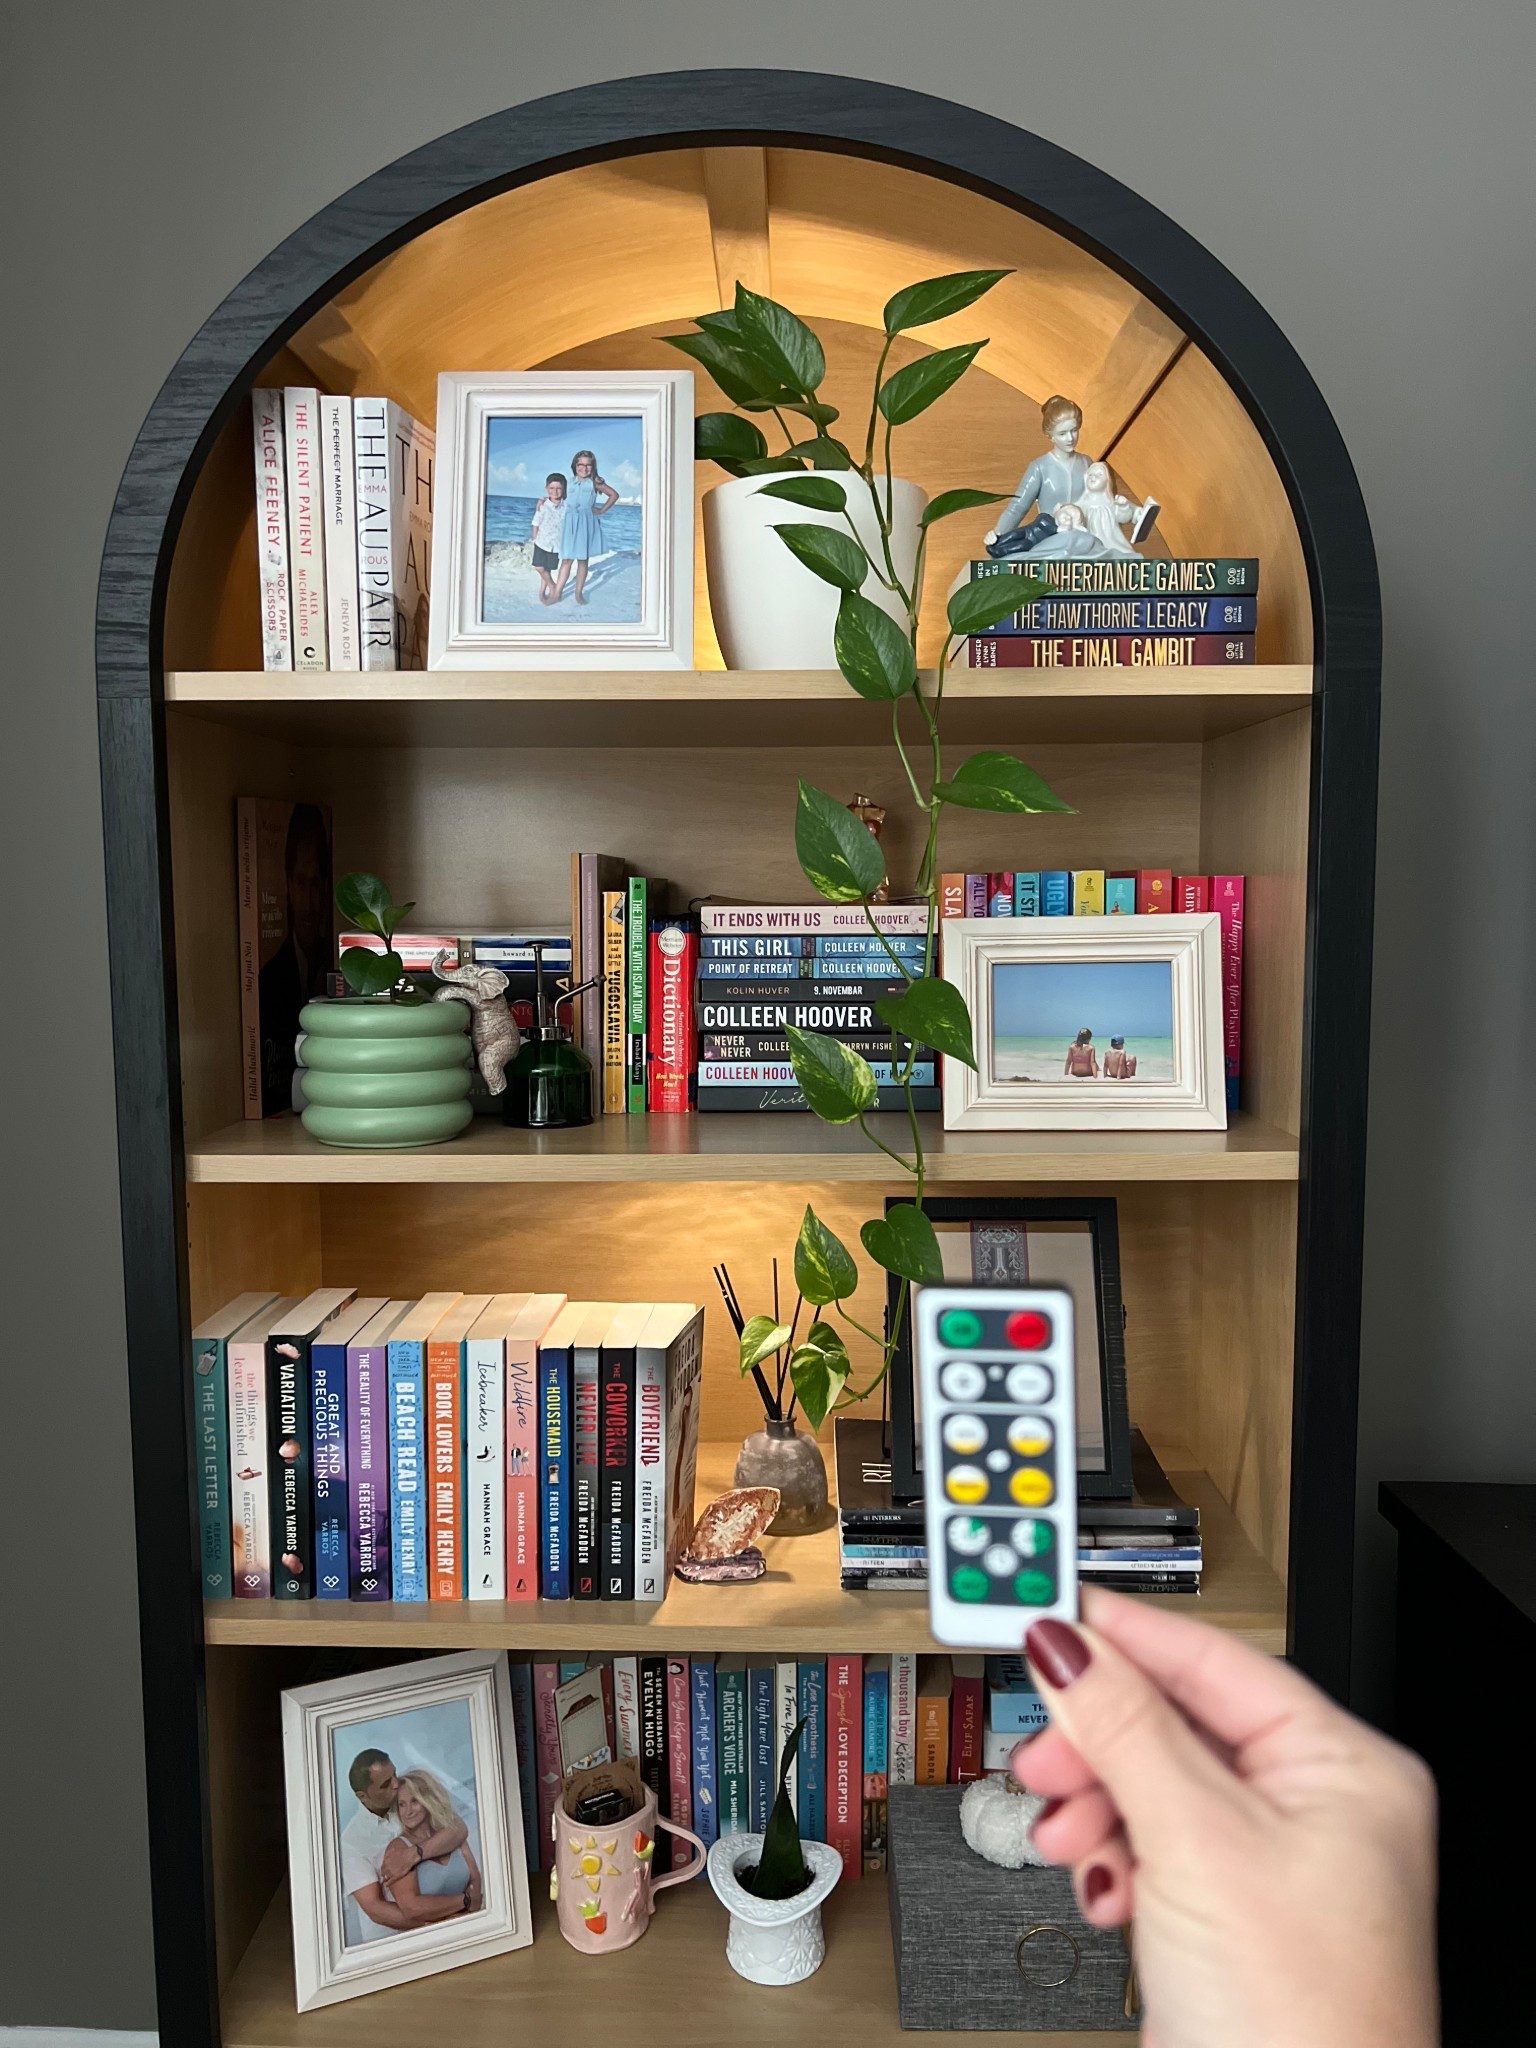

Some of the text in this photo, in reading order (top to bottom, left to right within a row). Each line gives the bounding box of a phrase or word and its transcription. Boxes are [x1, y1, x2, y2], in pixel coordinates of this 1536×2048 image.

[332, 406, 343, 526] THE PERFECT MARRIAGE
[356, 408, 386, 480] THE
[262, 415, 281, 546] ALICE FEENEY
[295, 402, 312, 556] THE SILENT PATIENT
[358, 484, 388, 494] EMMA
[358, 500, 388, 550] AU
[266, 582, 276, 632] SCISSORS
[276, 573, 288, 641] ROCK PAPER
[298, 568, 308, 638] MICHAELIDES
[310, 590, 318, 616] ALEX
[360, 572, 392, 650] PAIR
[1044, 562, 1216, 592] INHERITANCE GAMES
[340, 598, 351, 660] JENEVA ROSE
[1012, 602, 1208, 630] THE HAWTHORNE LEGACY
[1030, 637, 1196, 668] THE FINAL GAMBIT
[713, 912, 821, 927] IT ENDS WITH US
[874, 914, 910, 925] HOOVER
[1228, 919, 1242, 952] Happy
[1231, 902, 1240, 918] The
[502, 950, 526, 958] howard
[632, 899, 643, 1024] THE TROUBLE WITH ISLAM TODAY
[708, 964, 736, 974] POINT
[739, 964, 751, 974] OF
[754, 964, 793, 974] RETREAT
[712, 939, 750, 956] THIS
[754, 939, 792, 956] GIRL
[822, 963, 862, 974] COLLEEN
[824, 942, 866, 953] COLLEEN
[608, 970, 621, 1044] YUGOSLAVIA
[657, 957, 681, 1068] Dictionary
[703, 1006, 872, 1028] COLLEEN HOOVER
[726, 986, 790, 995] KOLIN HUVER
[823, 985, 863, 996] NOVEMBAR
[634, 1038, 642, 1060] Irshad
[706, 1067, 758, 1080] COLLEEN
[714, 1035, 745, 1047] NEVER
[720, 1047, 751, 1058] NEVER
[234, 1357, 248, 1456] leave unfinished
[246, 1390, 258, 1426] things
[280, 1364, 296, 1435] VARIATION
[358, 1353, 372, 1470] THE REALITY OF EVERYTHING
[477, 1360, 496, 1432] Icebreaker
[510, 1361, 530, 1430] Wildfire
[546, 1368, 561, 1458] THE HOUSEMAID
[576, 1382, 597, 1467] NEVER LIE
[605, 1362, 628, 1468] THE COWORKER
[640, 1384, 660, 1468] BOYFRIEND
[202, 1383, 218, 1509] THE LAST LETTER
[315, 1370, 329, 1499] PRECIOUS THINGS
[327, 1394, 340, 1475] GREAT AND
[284, 1468, 298, 1551] REBECCA YARROS
[396, 1382, 417, 1575] BEACH READ EMILY HENRY
[435, 1382, 455, 1575] BOOK LOVERS EMILY HENRY
[321, 1520, 329, 1555] YARROS
[358, 1482, 372, 1573] REBECCA YARROS
[482, 1483, 491, 1556] HANNAH GRACE
[549, 1491, 560, 1572] FREIDA McFADDEN
[578, 1479, 589, 1564] FREIDA McFADDEN
[611, 1480, 622, 1565] FREIDA McFADDEN
[641, 1480, 652, 1565] FREIDA McFADDEN
[617, 1670, 634, 1705] Every
[644, 1671, 656, 1758] EVELYN HUGO
[895, 1666, 911, 1738] thousand boy
[1018, 1715, 1048, 1724] NEVER
[656, 1708, 664, 1754] HUSBANDS
[722, 1690, 736, 1776] ARCHER'S VOICE
[755, 1698, 771, 1766] light lost
[806, 1704, 820, 1759] Hypothesis
[838, 1664, 849, 1824] THE LOVE DECEPTION
[868, 1691, 876, 1754] LAURIE GILMORE
[962, 1730, 973, 1758] ELIF
[759, 1779, 767, 1797] JILL
[927, 1743, 936, 1780] SANDRA
